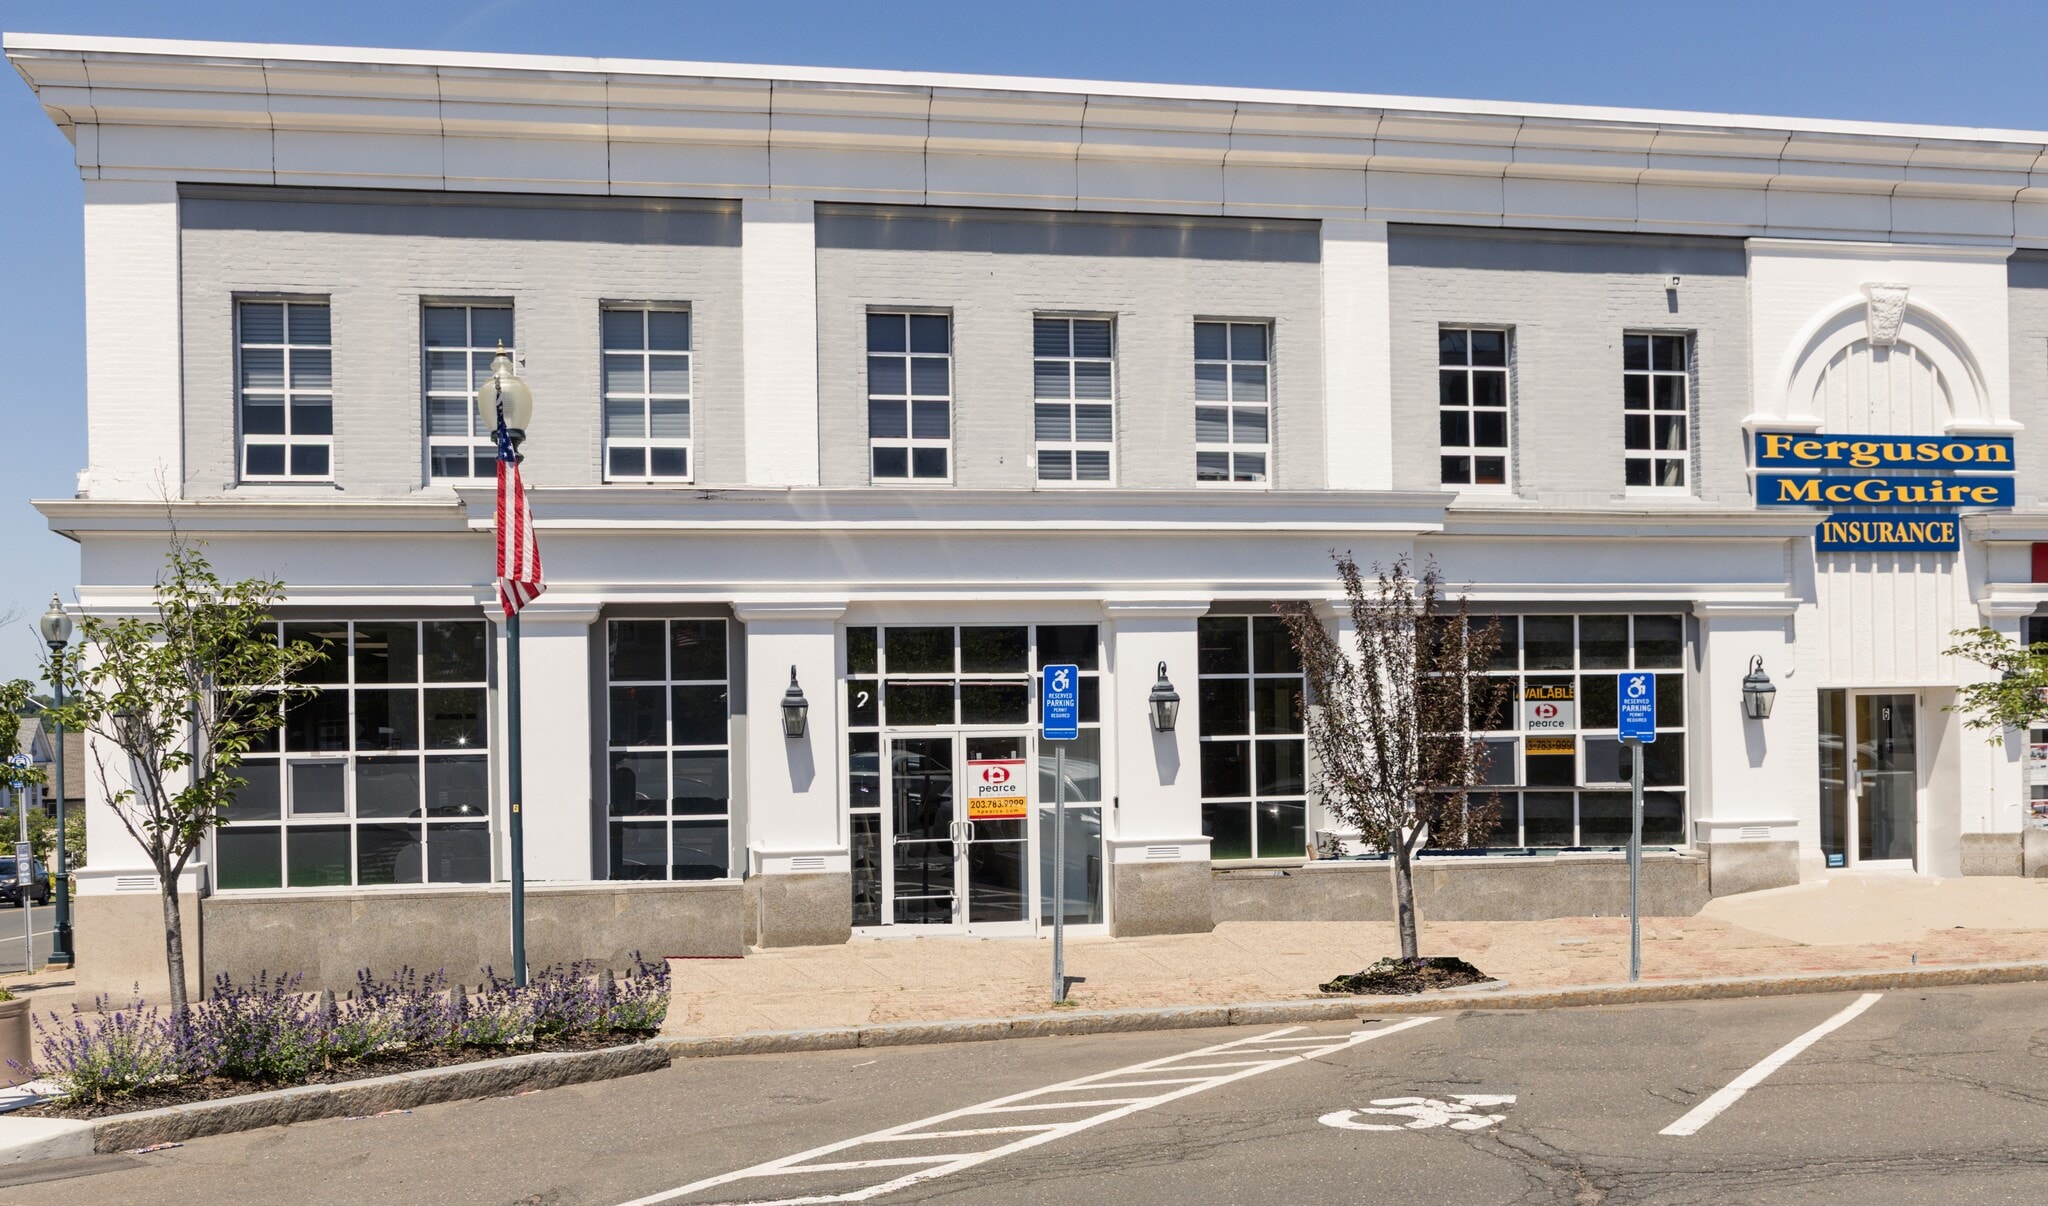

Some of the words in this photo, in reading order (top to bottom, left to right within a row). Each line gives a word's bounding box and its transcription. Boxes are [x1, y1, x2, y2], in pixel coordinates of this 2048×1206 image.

[1762, 434, 2010, 468] Ferguson
[1776, 479, 1999, 503] McGuire
[1822, 521, 1955, 543] INSURANCE
[1046, 699, 1074, 707] PARKING
[1621, 704, 1652, 712] PARKING
[1529, 720, 1565, 731] pearce
[979, 784, 1016, 797] pearce
[970, 799, 1024, 808] 203.783.9999
